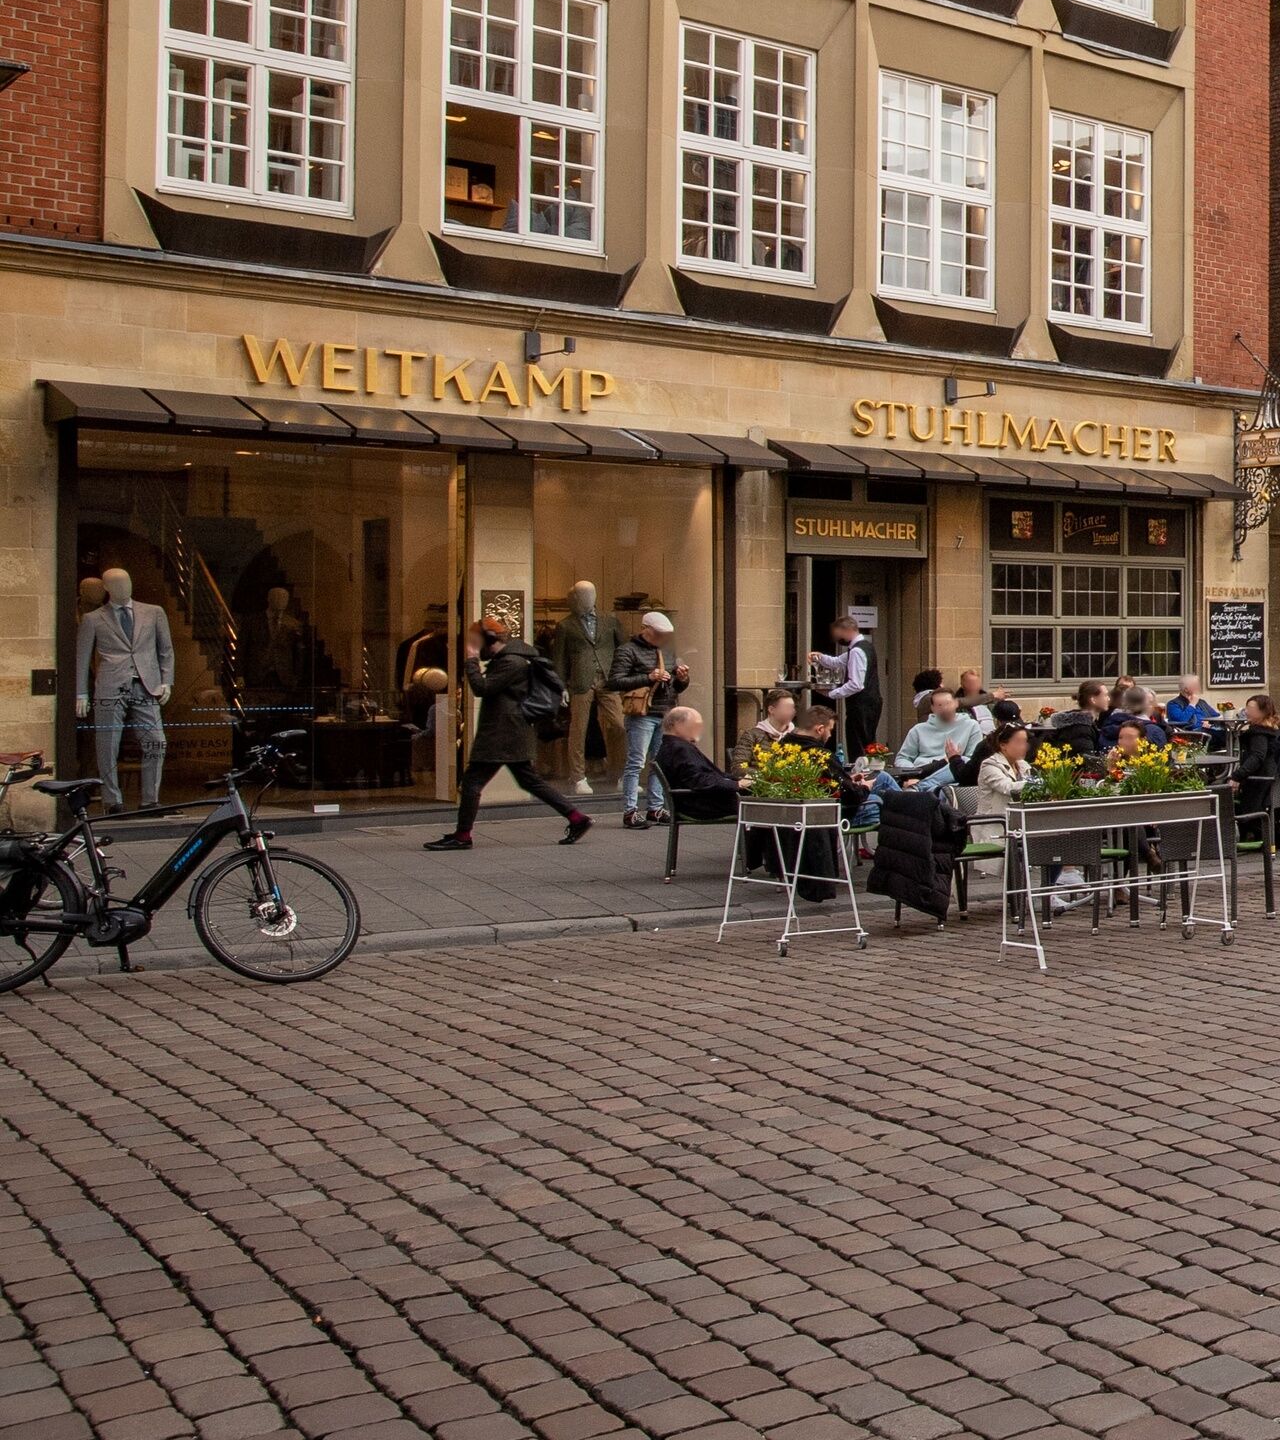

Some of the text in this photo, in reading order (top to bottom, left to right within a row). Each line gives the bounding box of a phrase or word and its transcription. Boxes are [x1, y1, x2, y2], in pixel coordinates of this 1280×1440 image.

[242, 334, 616, 412] WEITKAMP
[852, 398, 1179, 463] STUHLMACHER
[794, 517, 917, 541] STUHLMACHER
[1063, 511, 1107, 536] Pilsner
[955, 535, 965, 549] 7
[1205, 586, 1266, 598] RESTAURANT
[145, 739, 229, 750] THE NEW EASY
